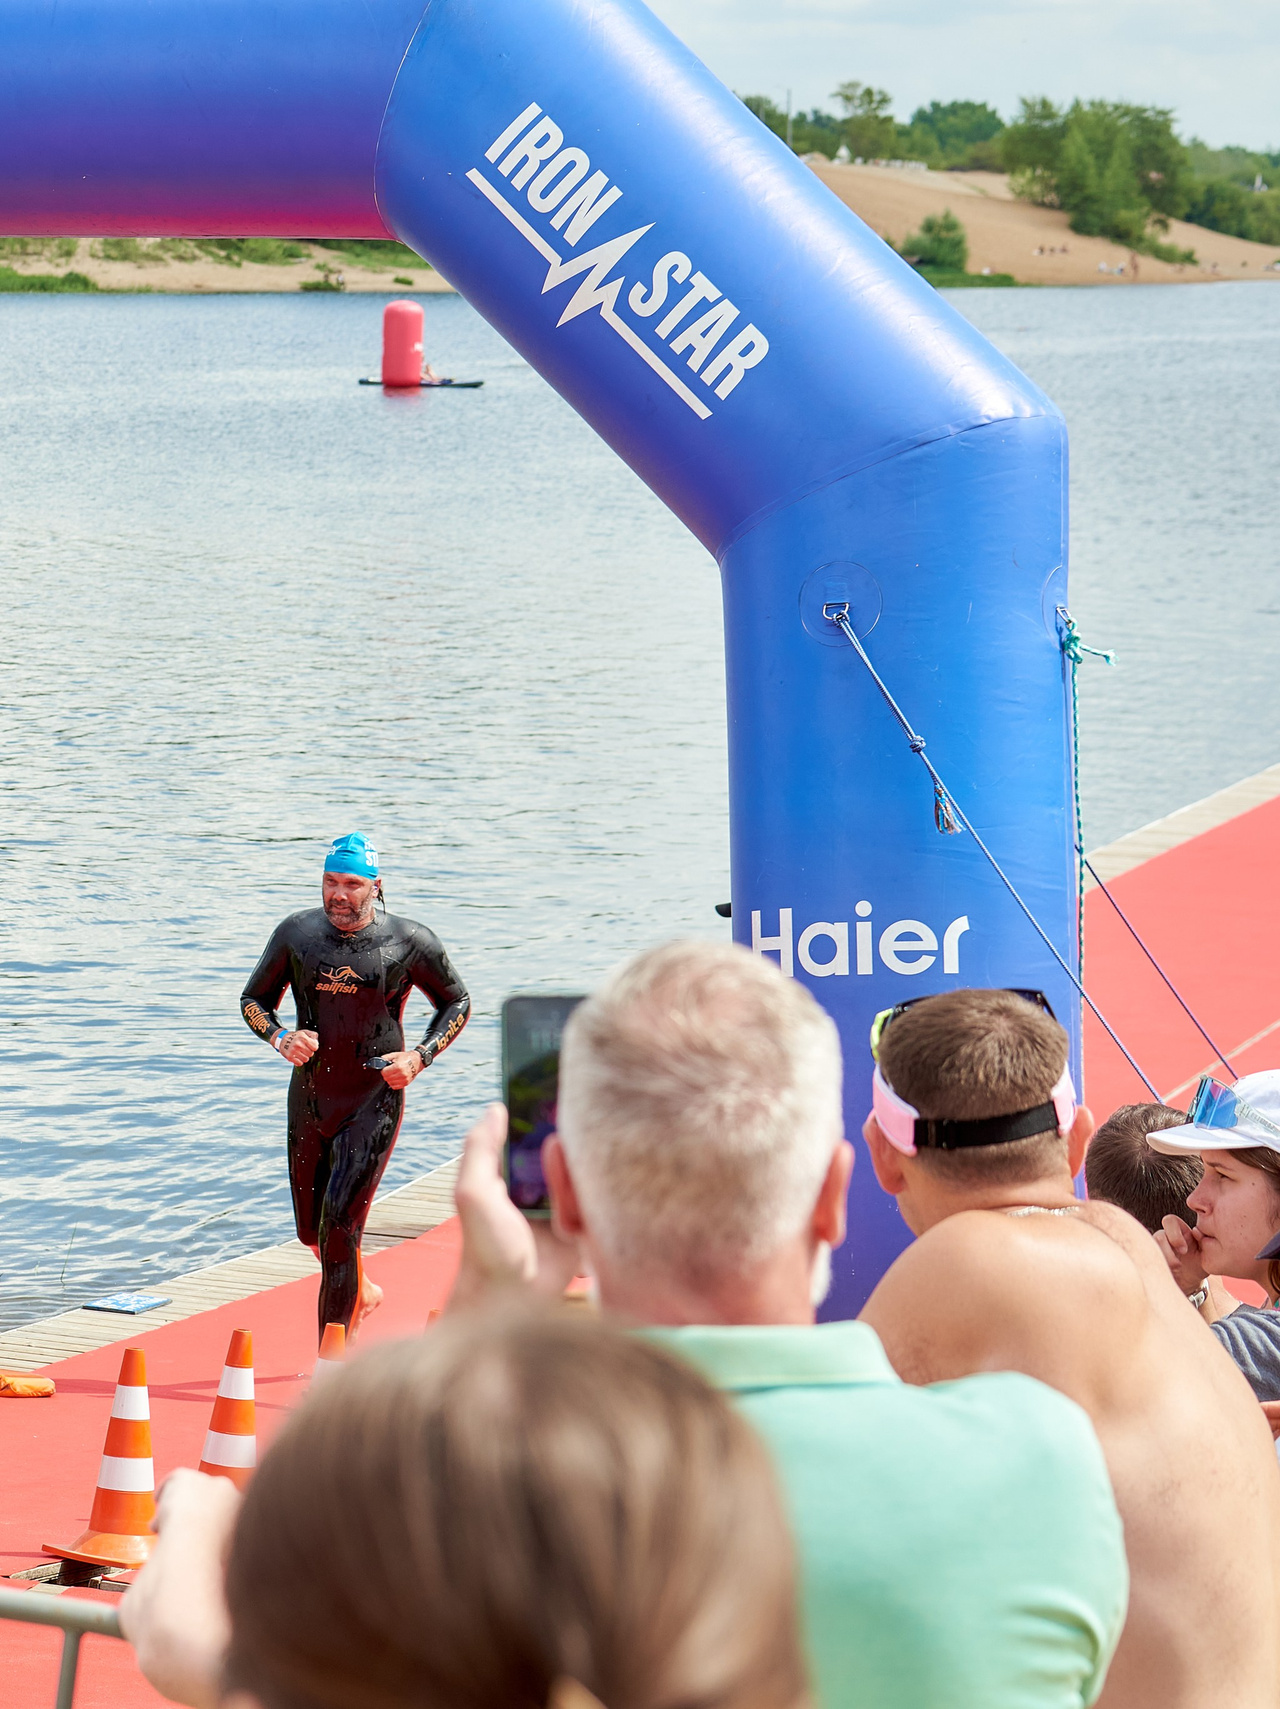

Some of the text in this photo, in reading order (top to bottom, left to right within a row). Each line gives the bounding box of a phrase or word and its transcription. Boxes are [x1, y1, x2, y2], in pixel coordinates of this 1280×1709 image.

[484, 101, 769, 400] IRON STAR
[751, 900, 970, 978] Haier
[315, 981, 358, 995] sailfish
[435, 1013, 465, 1050] Ignite
